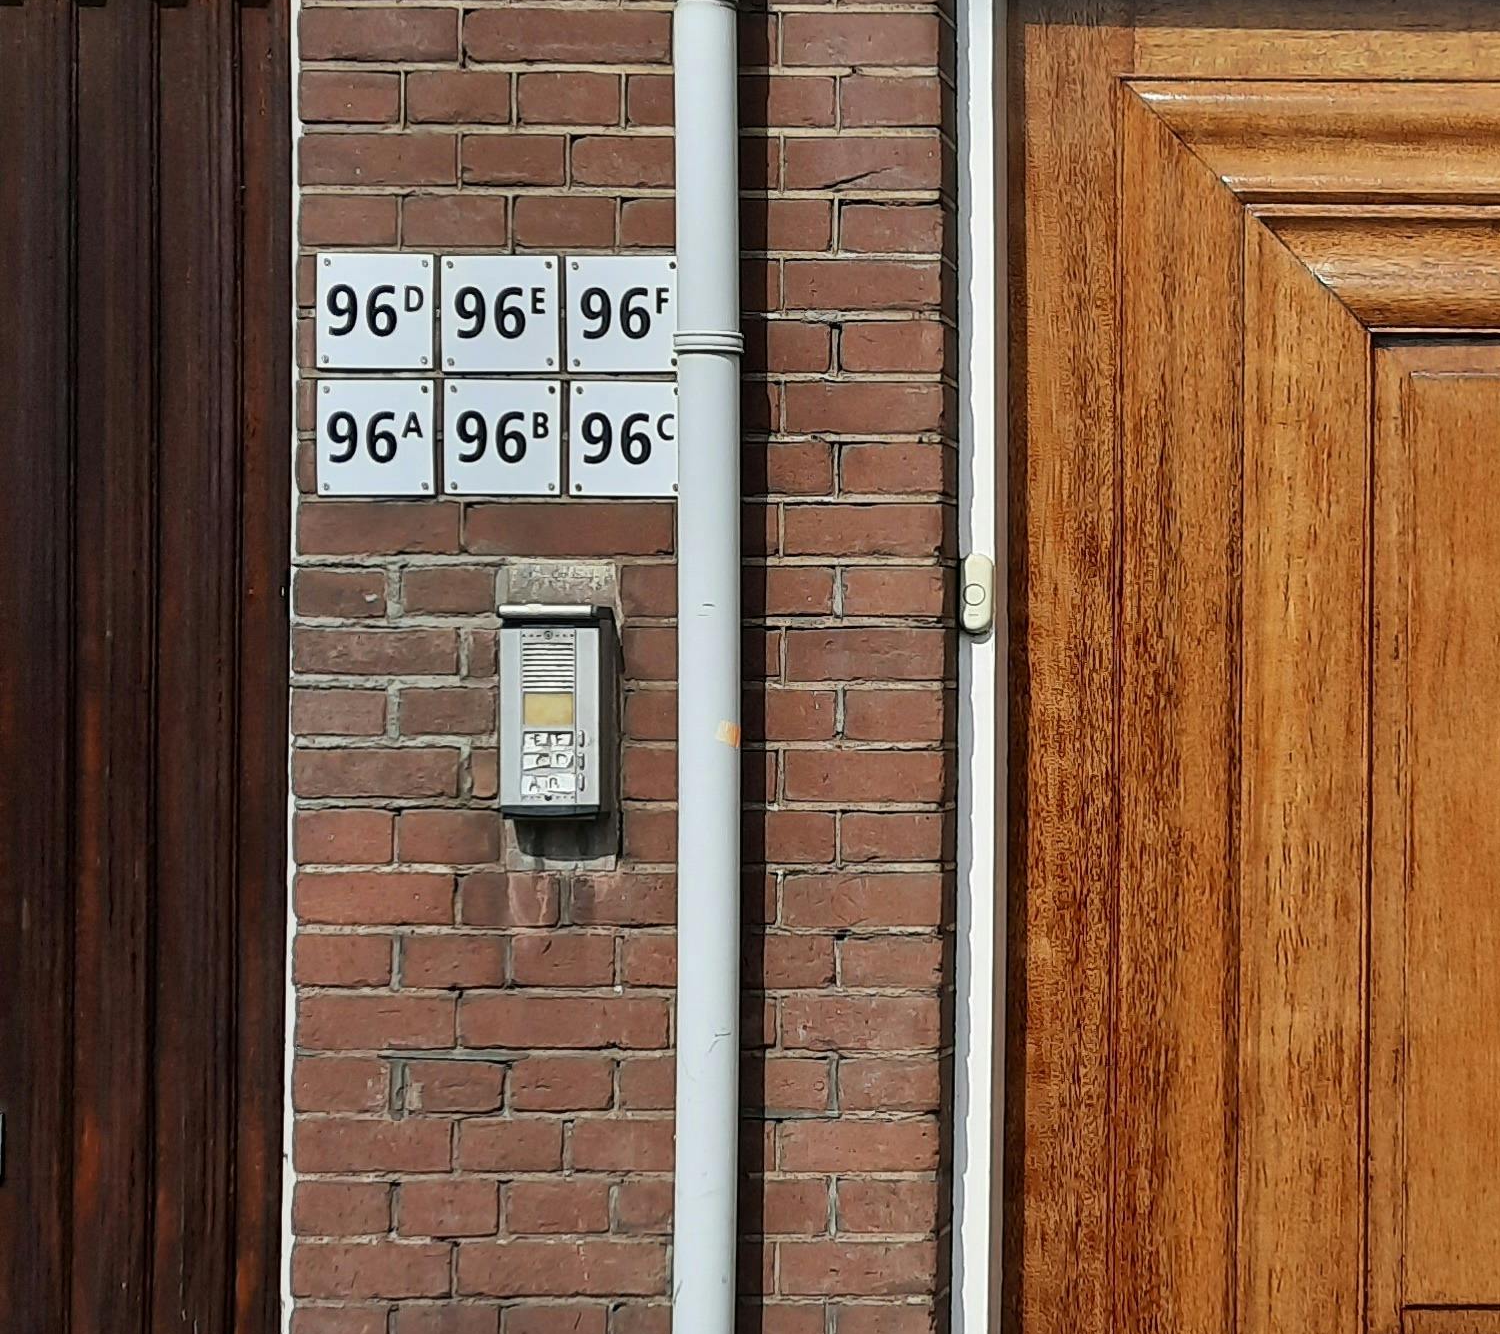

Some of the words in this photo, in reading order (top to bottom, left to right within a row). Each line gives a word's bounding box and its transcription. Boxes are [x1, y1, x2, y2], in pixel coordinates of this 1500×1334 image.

[326, 283, 424, 337] 96D
[454, 285, 546, 339] 96E
[579, 286, 670, 340] 96F
[326, 410, 423, 464] 96A
[454, 409, 549, 464] 96B
[580, 411, 675, 465] 96C
